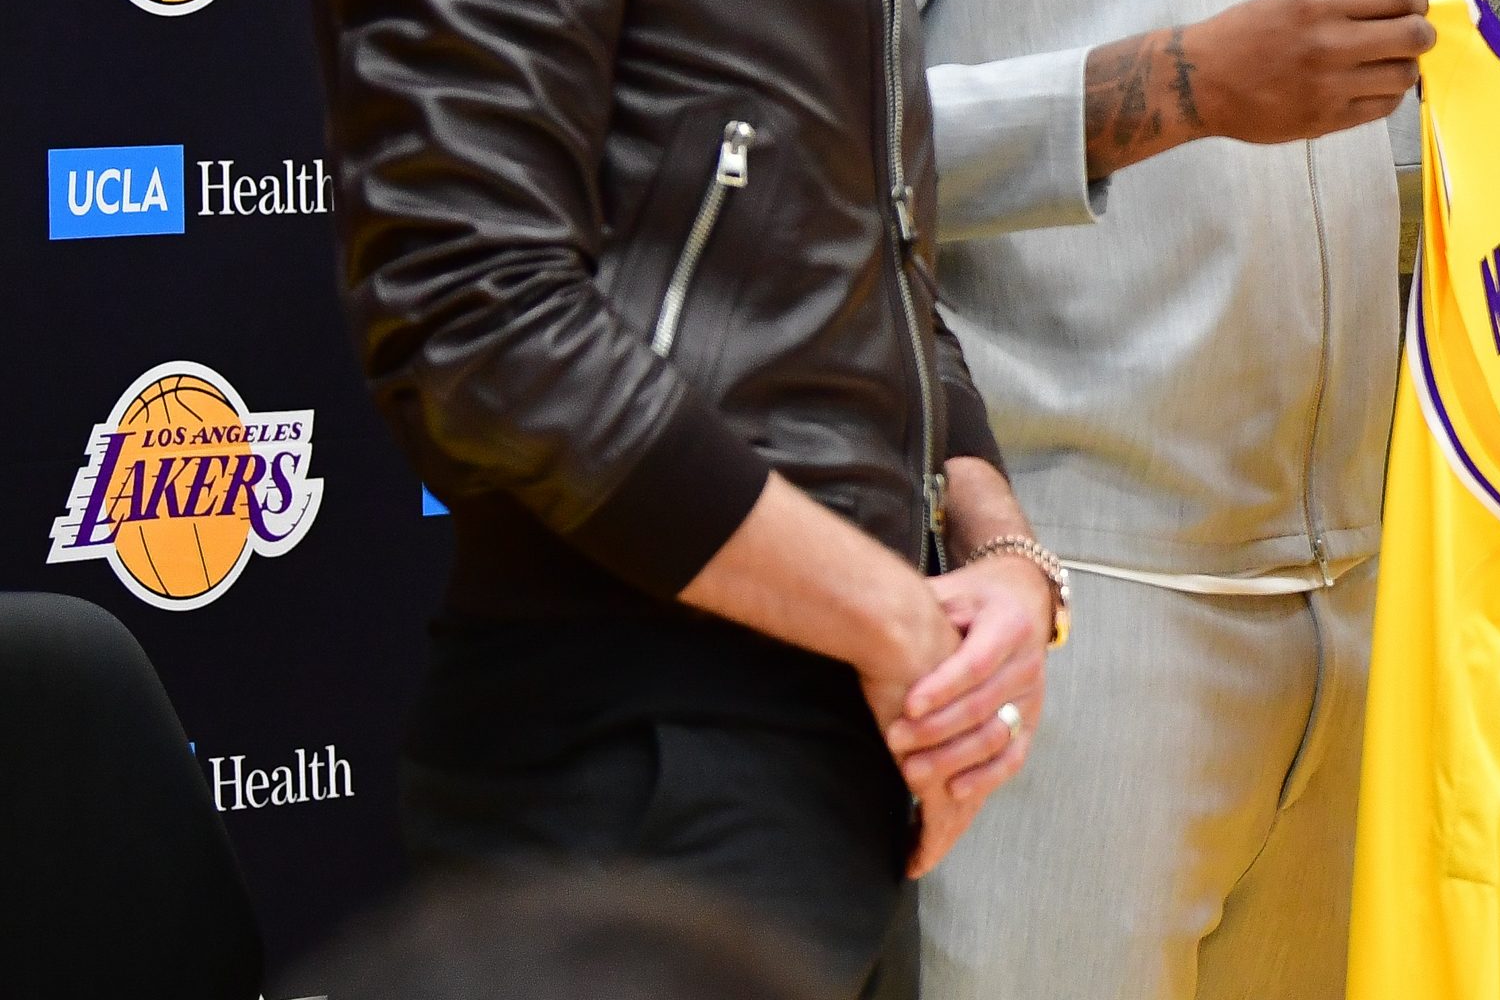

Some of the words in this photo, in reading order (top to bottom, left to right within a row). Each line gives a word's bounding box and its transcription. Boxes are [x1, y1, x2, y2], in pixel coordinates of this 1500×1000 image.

[67, 166, 168, 214] UCLA
[197, 158, 335, 216] Health
[142, 427, 187, 448] LOS
[189, 422, 303, 445] ANGELES
[62, 432, 312, 549] LAKERS
[209, 745, 354, 812] Health
